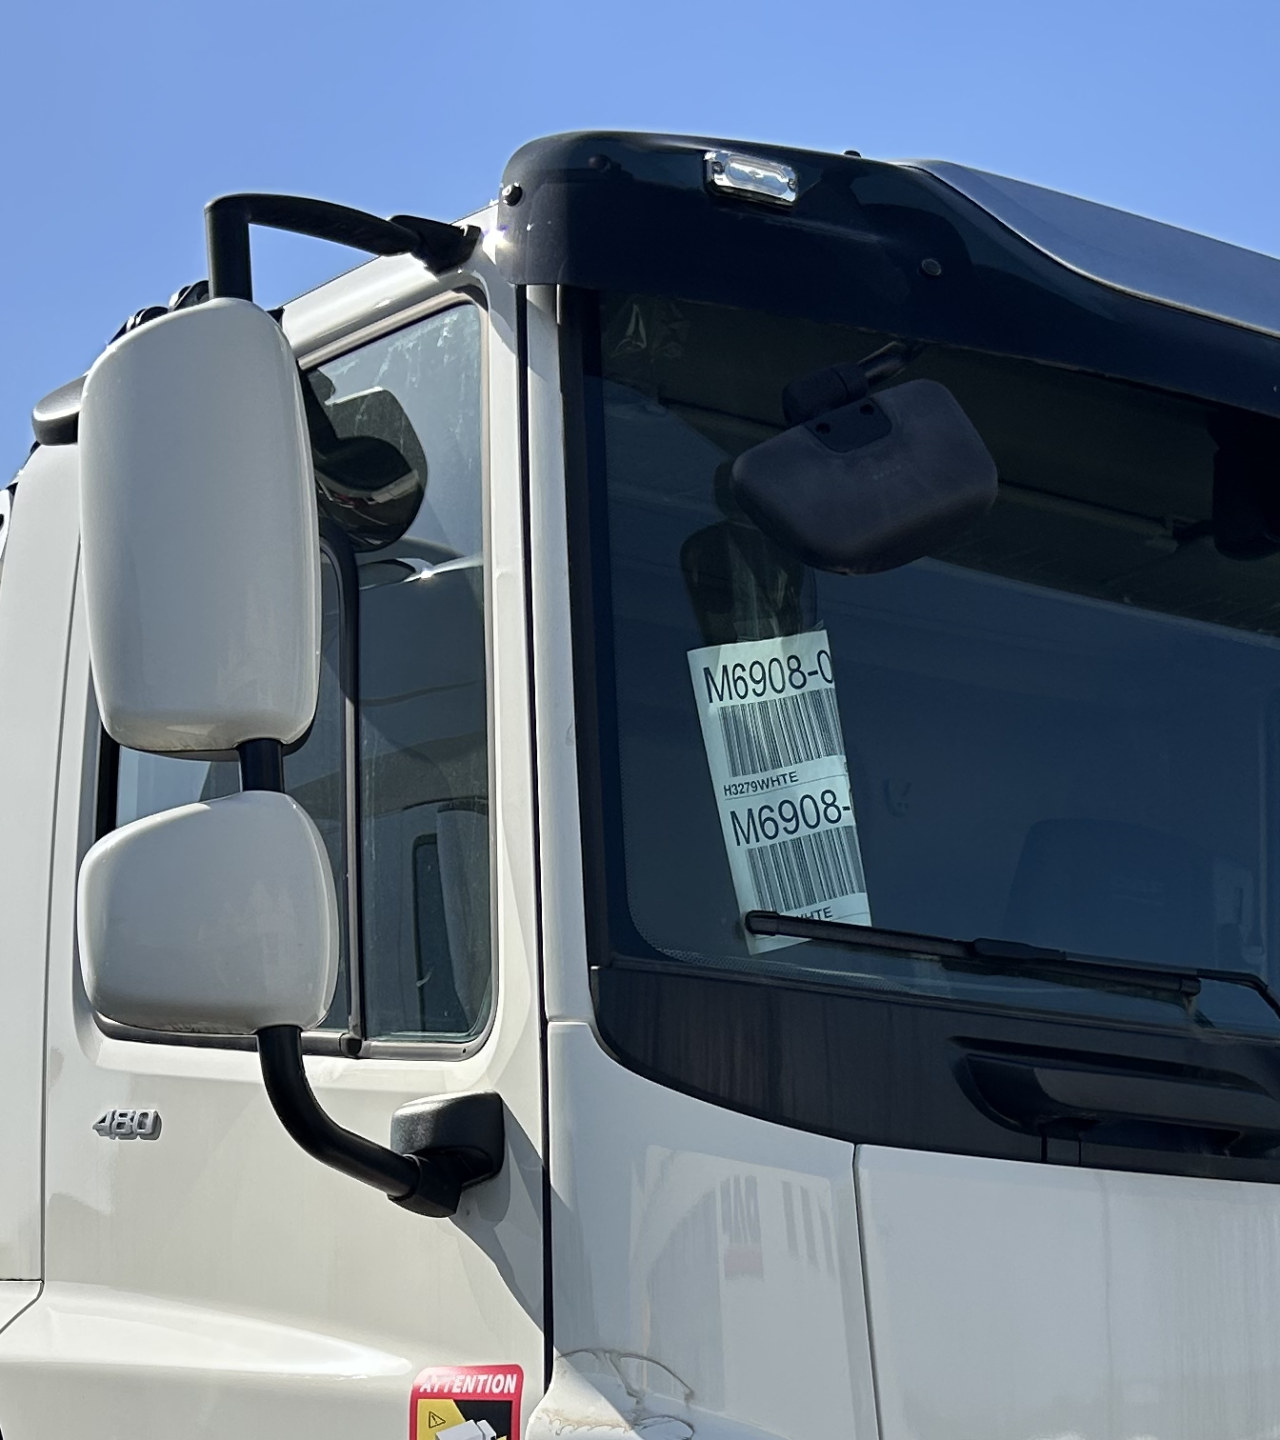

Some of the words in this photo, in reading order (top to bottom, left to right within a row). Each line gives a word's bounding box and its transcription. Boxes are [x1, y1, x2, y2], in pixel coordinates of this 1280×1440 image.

[703, 650, 834, 703] M6908-0
[723, 771, 799, 796] H3279WHTE
[730, 789, 851, 846] M6908-
[92, 1108, 160, 1140] 480
[420, 1373, 517, 1395] ATTENTION
